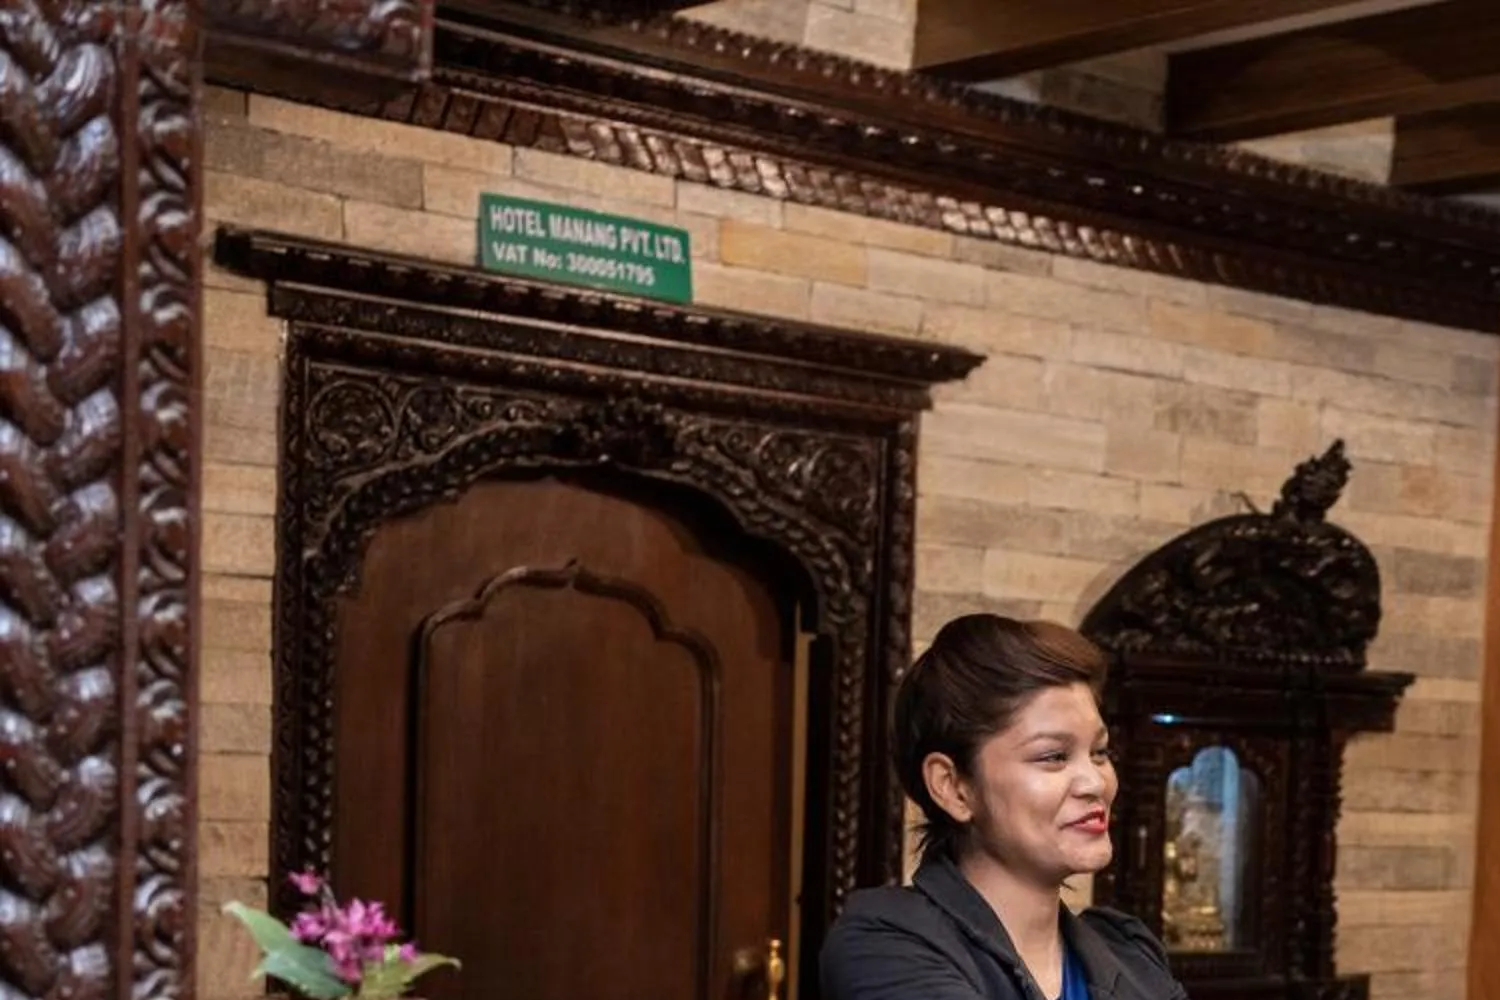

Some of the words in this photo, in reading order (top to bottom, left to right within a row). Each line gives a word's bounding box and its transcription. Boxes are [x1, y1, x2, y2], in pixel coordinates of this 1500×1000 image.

[489, 204, 546, 238] HOTEL
[548, 213, 617, 250] MANANG
[492, 241, 529, 263] VAT
